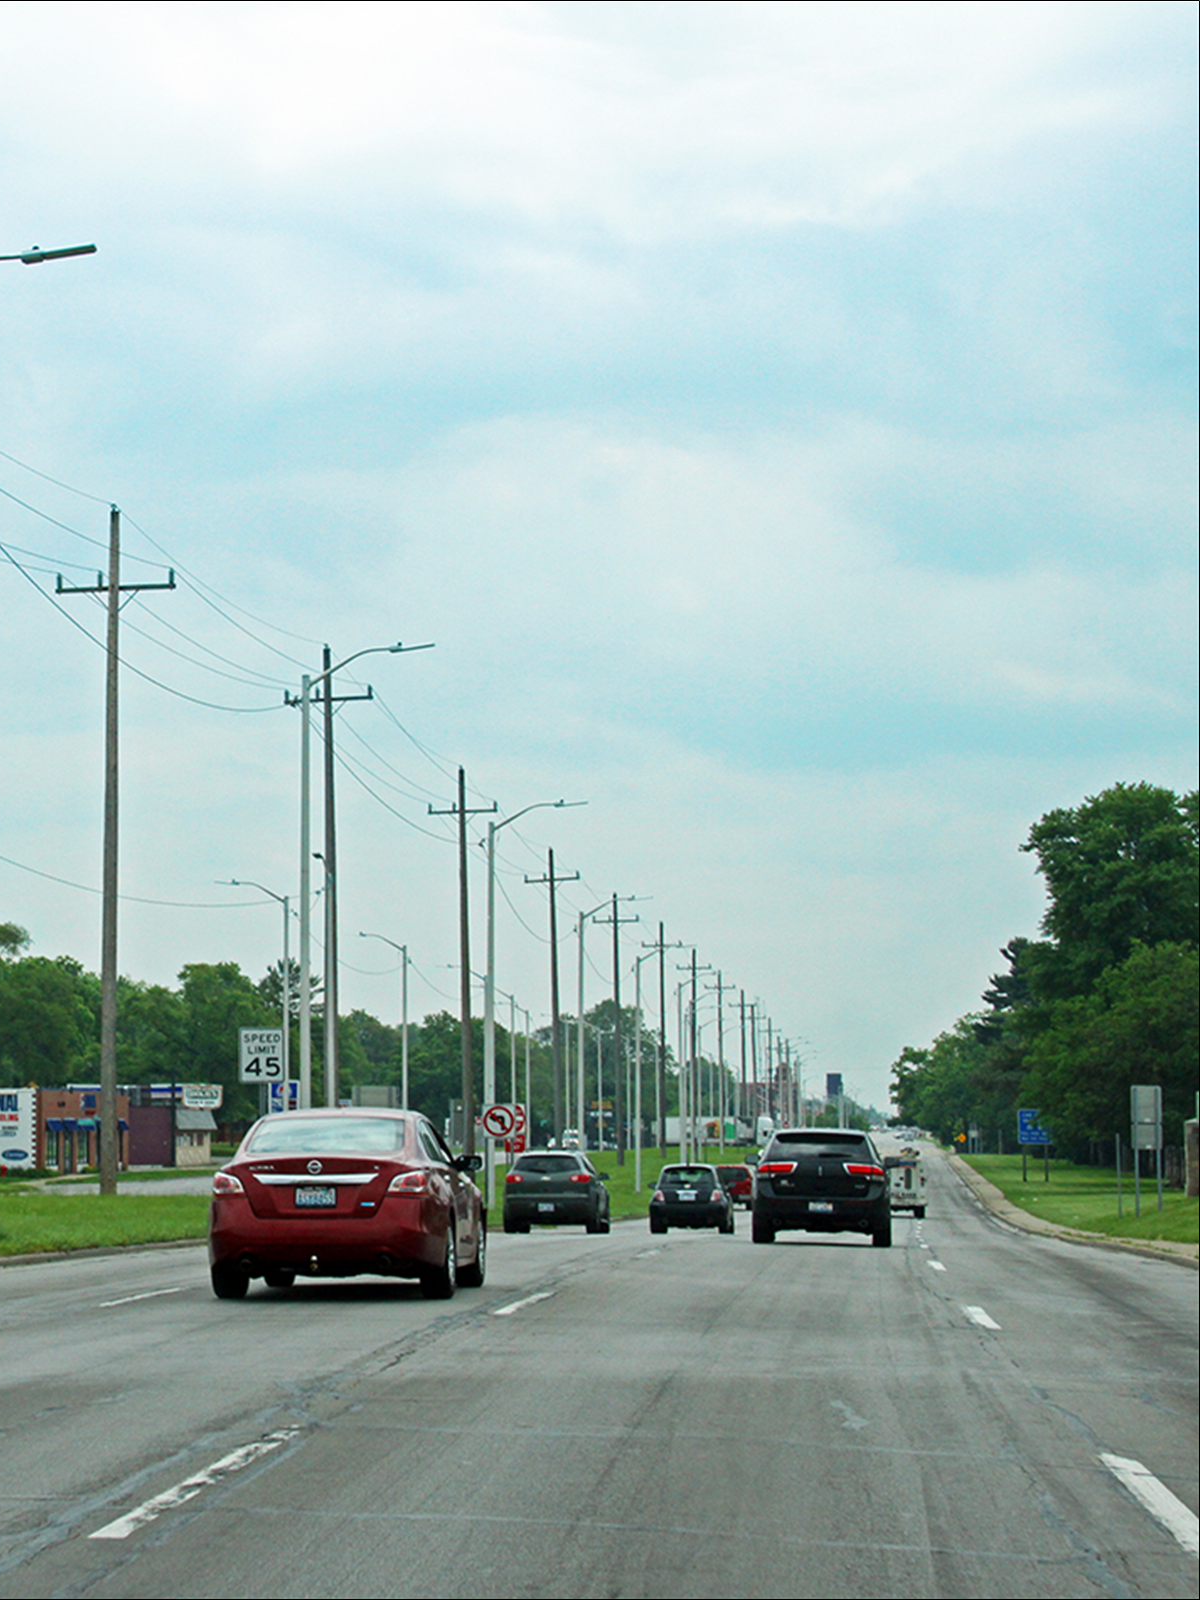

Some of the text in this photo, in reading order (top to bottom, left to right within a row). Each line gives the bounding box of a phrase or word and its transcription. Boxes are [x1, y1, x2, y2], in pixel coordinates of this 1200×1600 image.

[243, 1033, 280, 1043] SPEED
[247, 1046, 276, 1055] LIMIT
[244, 1057, 280, 1076] 45
